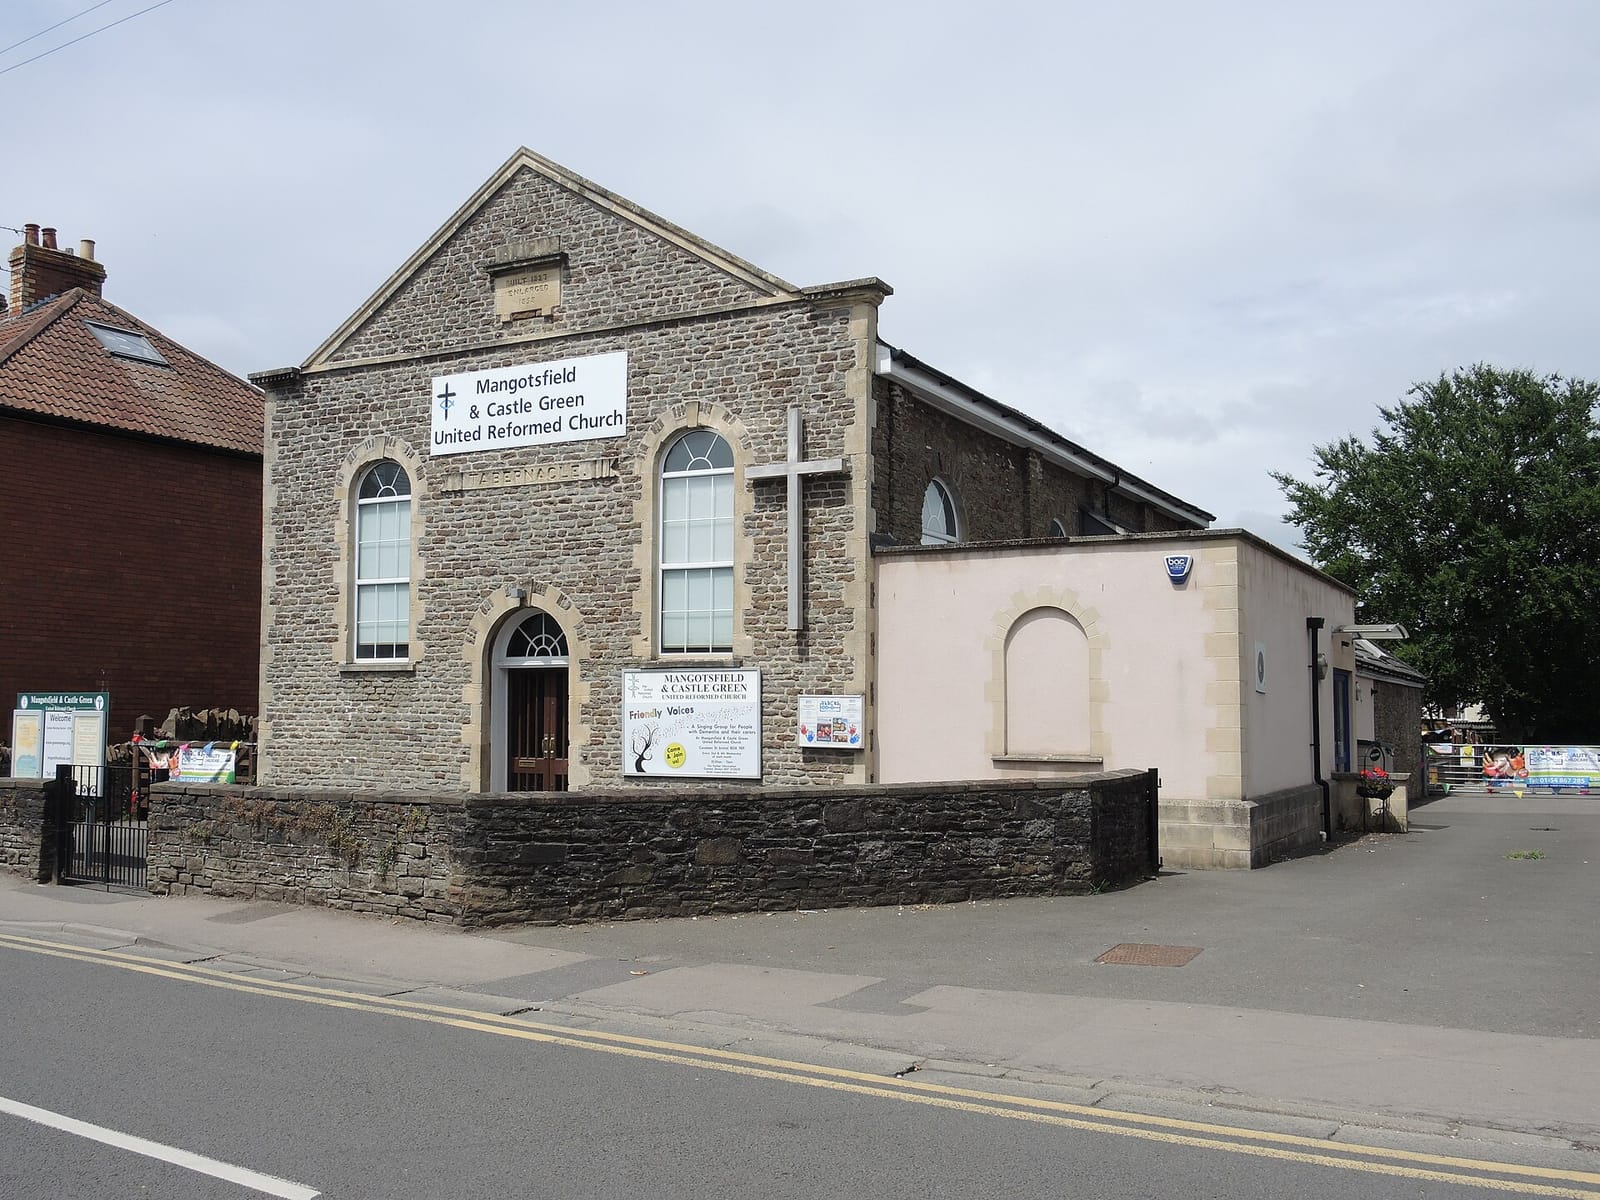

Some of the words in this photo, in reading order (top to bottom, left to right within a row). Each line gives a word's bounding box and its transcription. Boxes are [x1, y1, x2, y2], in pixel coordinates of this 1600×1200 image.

[476, 366, 576, 395] Mangotsfield
[470, 404, 480, 420] &
[487, 397, 532, 417] Castle
[539, 393, 585, 411] Green
[434, 425, 481, 446] United
[488, 416, 562, 440] Reformed
[569, 410, 623, 431] Church
[665, 674, 744, 682] MANGOTSFIELD
[661, 684, 668, 692] &
[672, 684, 710, 692] CASTLE
[712, 684, 748, 692] GREEN
[50, 714, 72, 722] Welcome
[630, 708, 662, 720] Friendly
[666, 706, 694, 716] Voices
